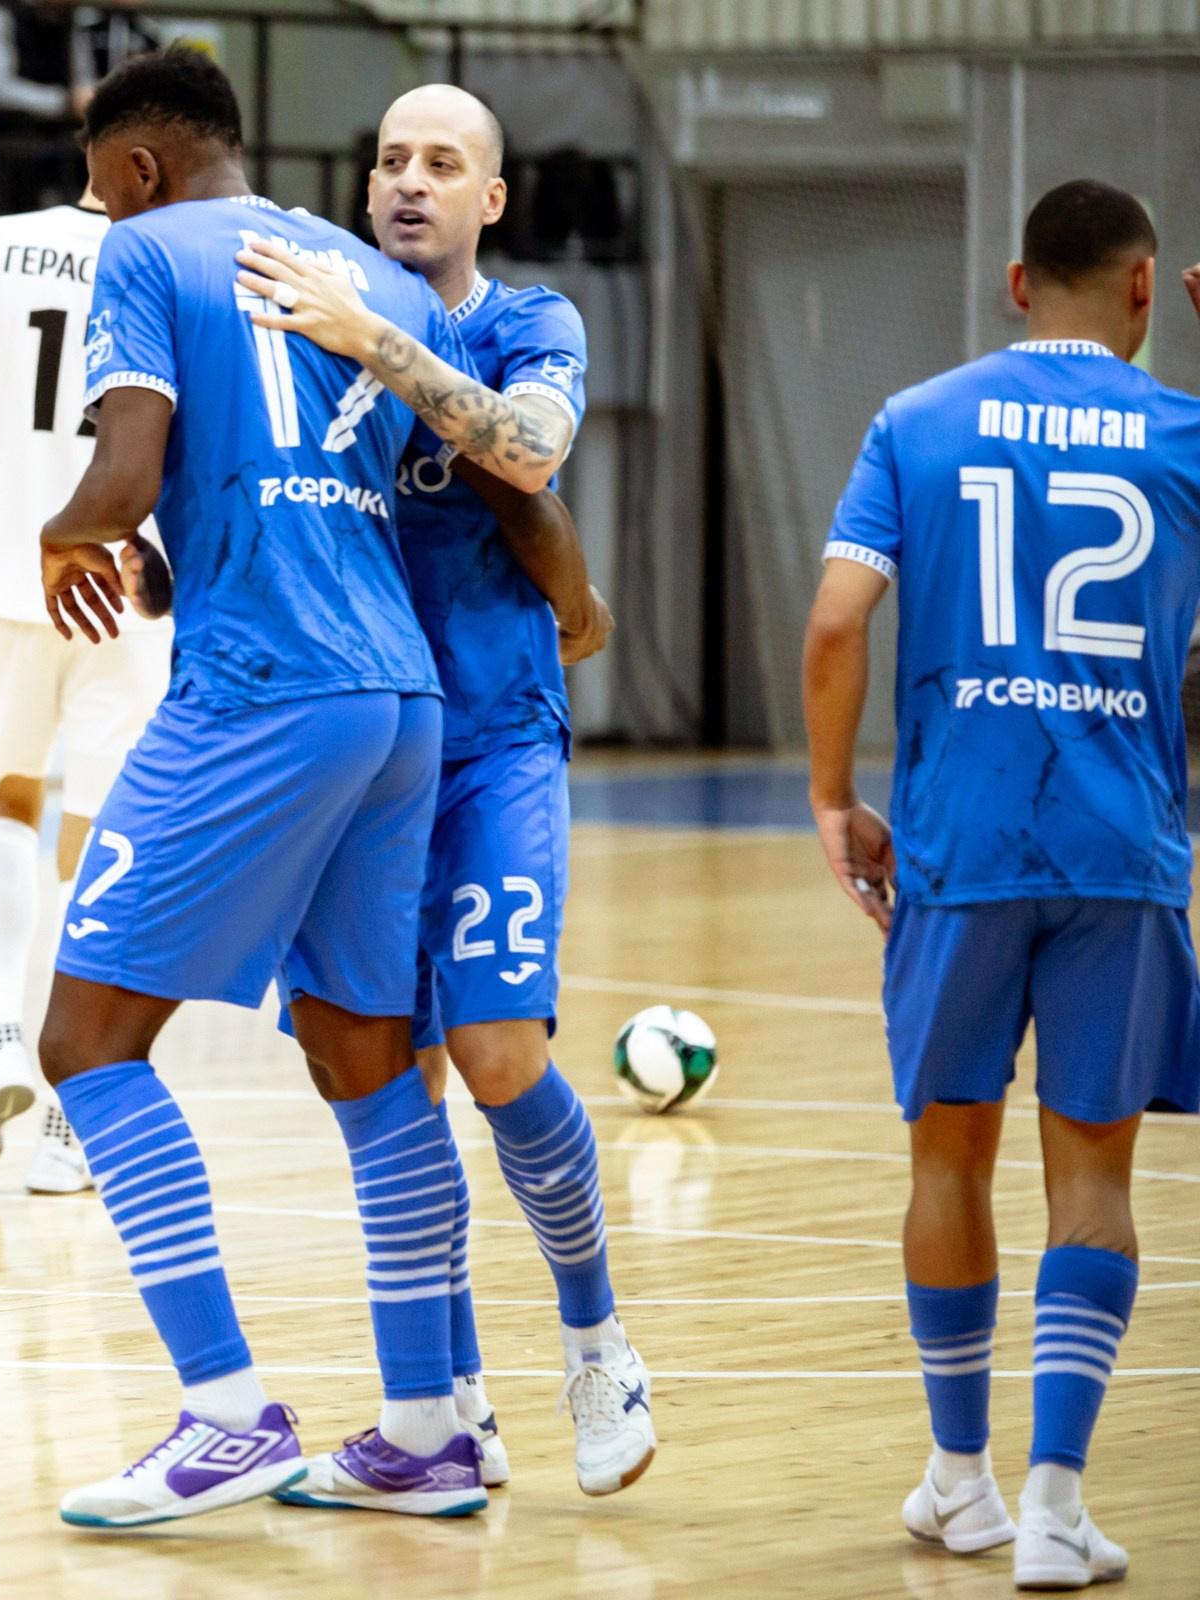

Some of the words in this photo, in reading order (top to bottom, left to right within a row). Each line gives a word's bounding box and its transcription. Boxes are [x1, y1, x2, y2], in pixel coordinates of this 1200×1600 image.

[958, 466, 1155, 660] 12
[985, 676, 1147, 718] сервико
[452, 876, 546, 961] 22
